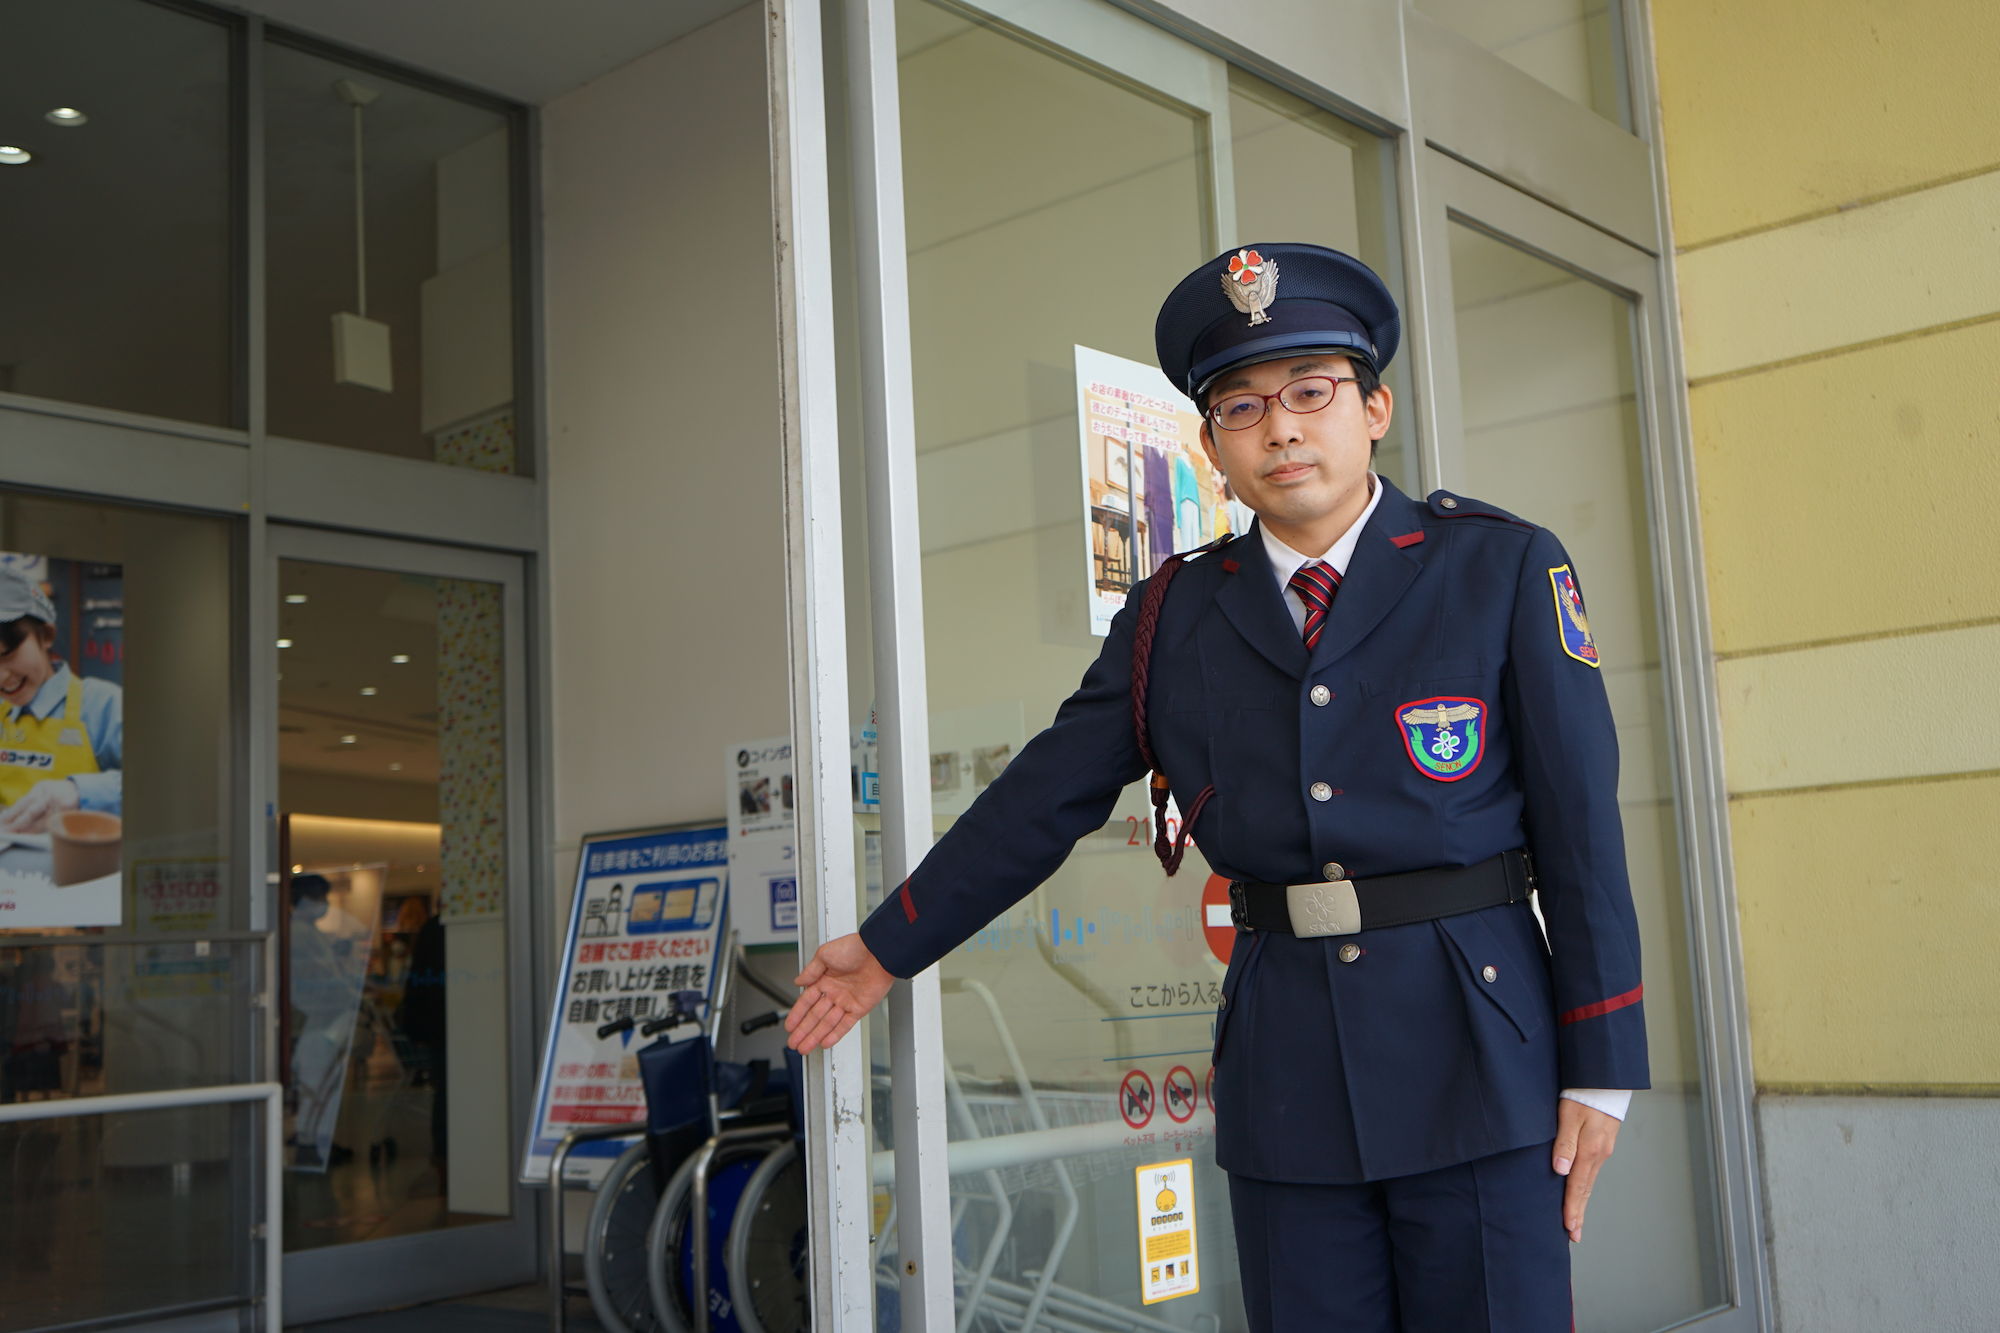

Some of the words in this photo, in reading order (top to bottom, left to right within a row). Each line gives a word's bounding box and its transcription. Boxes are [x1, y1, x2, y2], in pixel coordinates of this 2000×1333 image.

[1434, 760, 1462, 772] SENON
[572, 965, 707, 993] お買い上げ金額を
